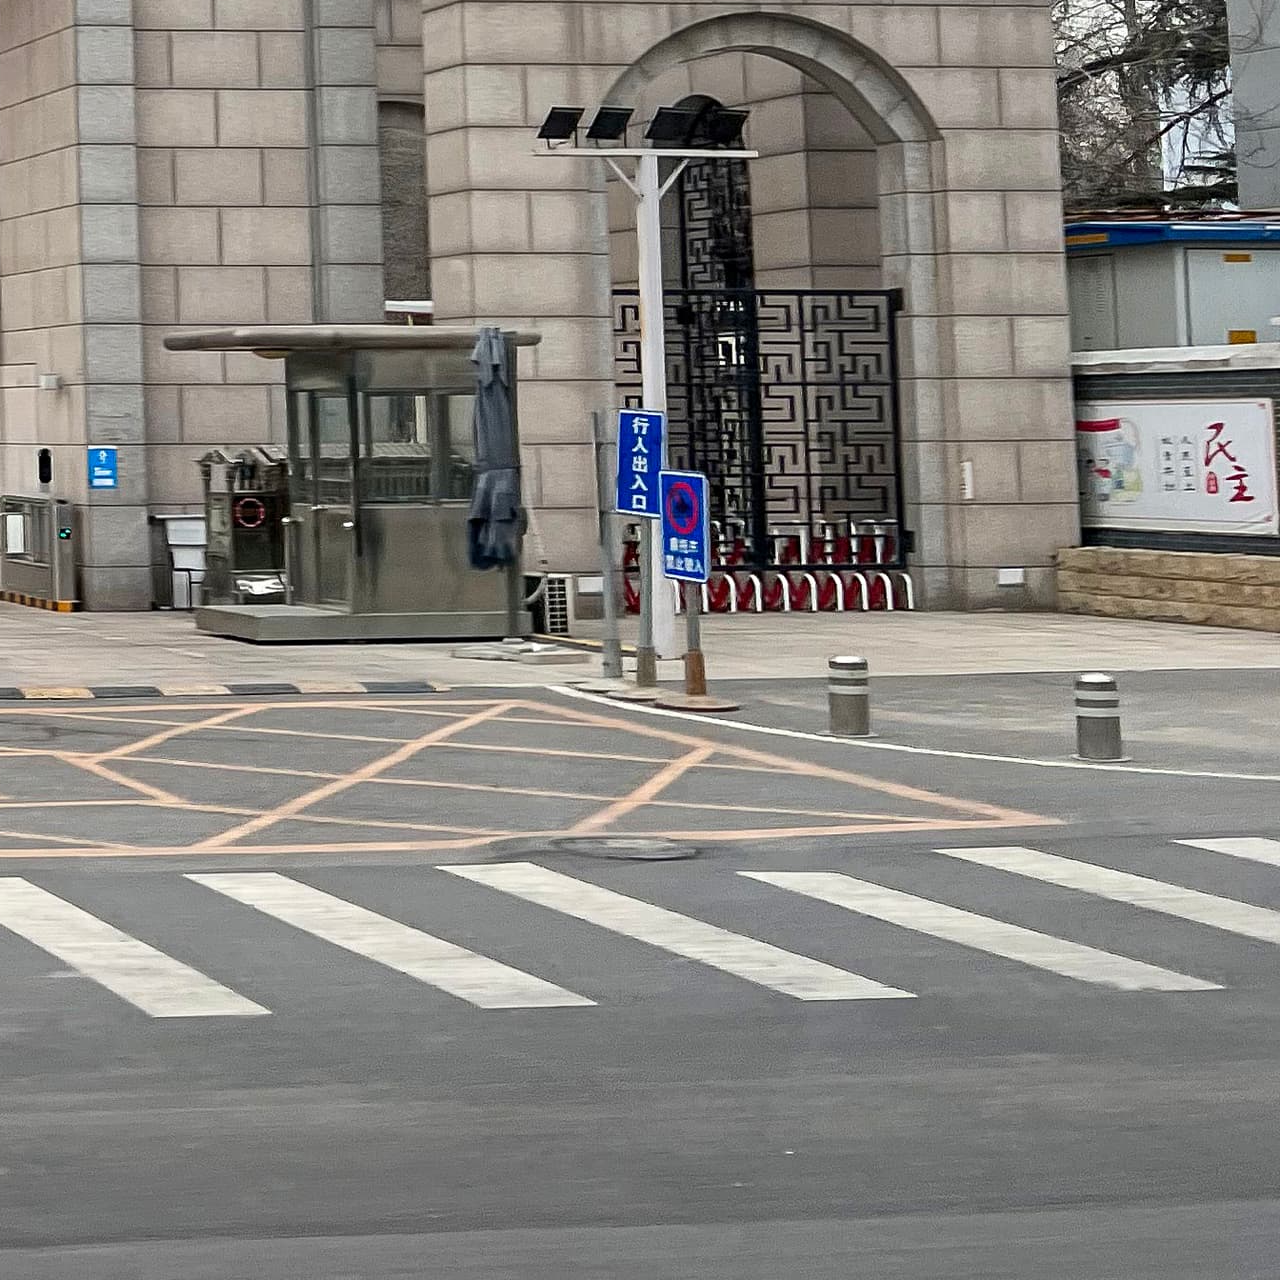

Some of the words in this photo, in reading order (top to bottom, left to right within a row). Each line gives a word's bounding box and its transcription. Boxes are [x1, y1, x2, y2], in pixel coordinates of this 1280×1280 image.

[630, 416, 649, 511] 行人出入口
[1204, 422, 1255, 503] 民主
